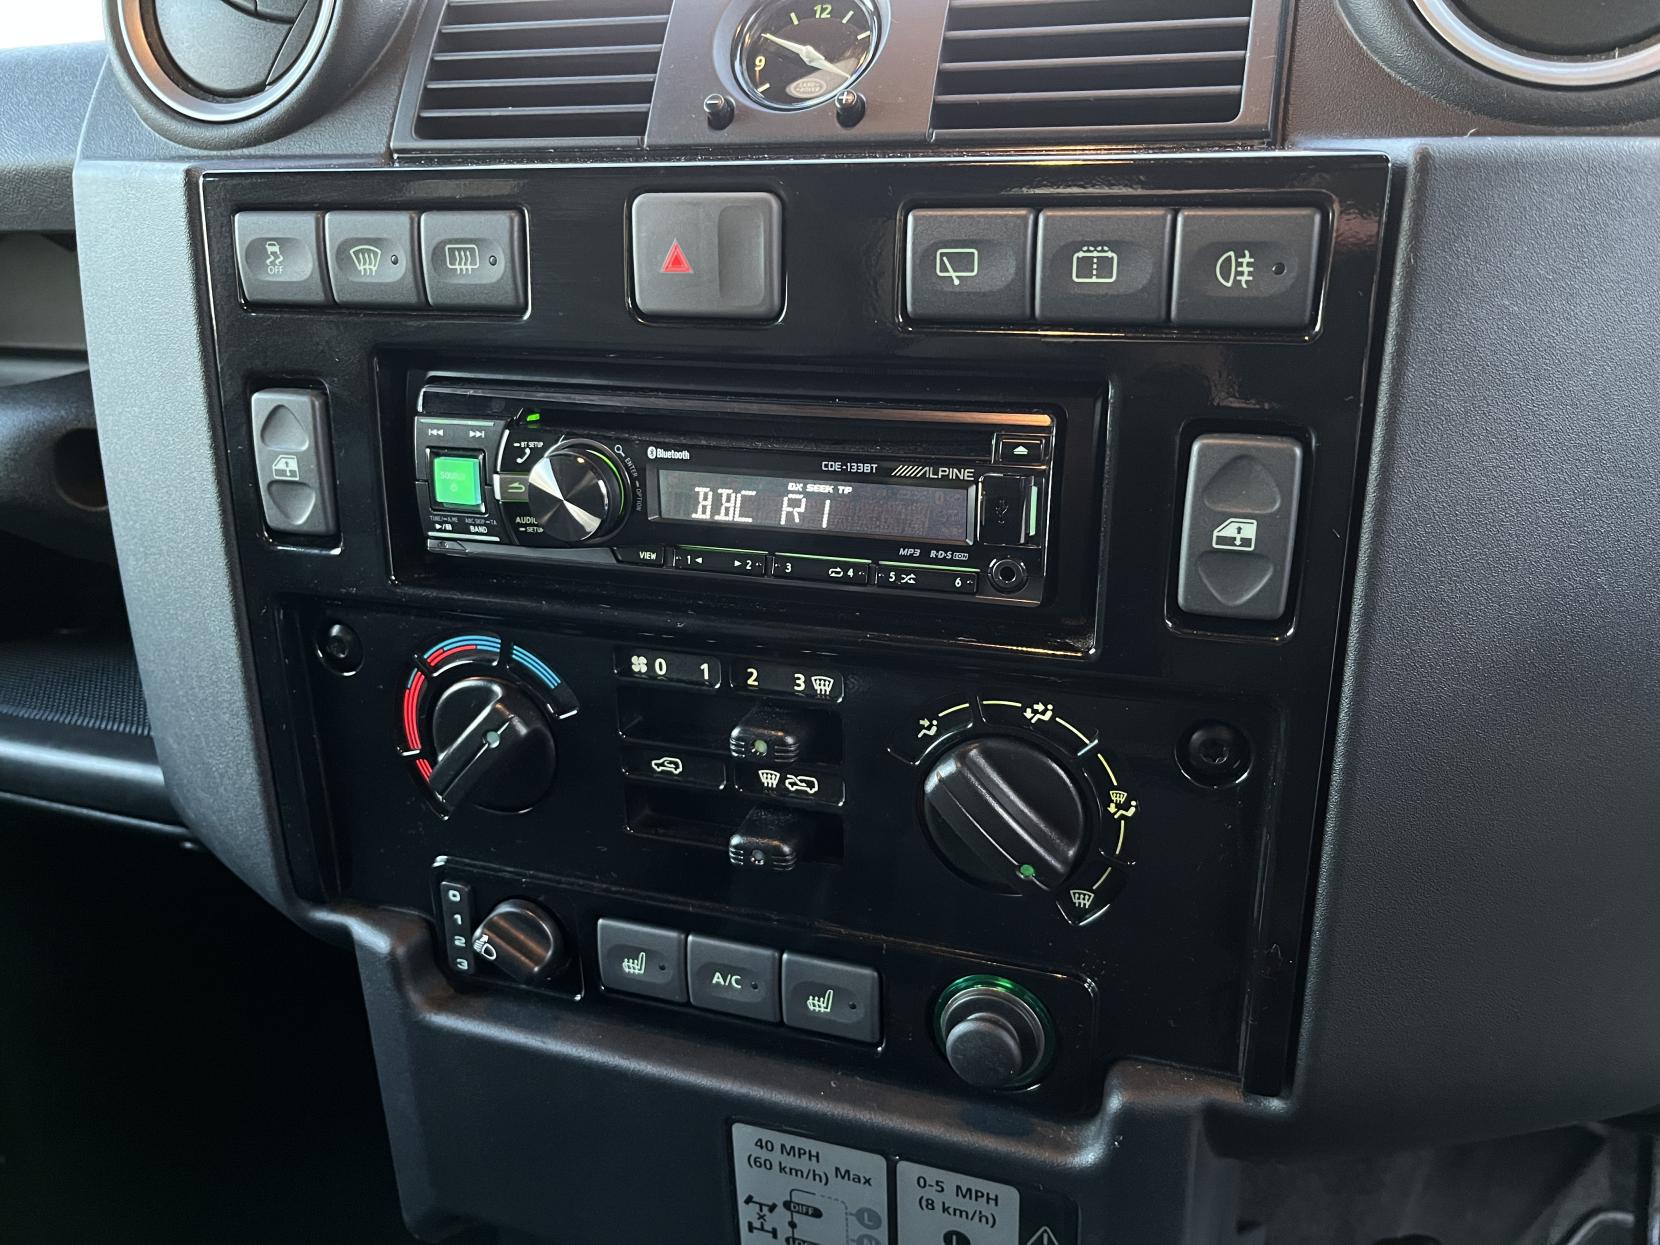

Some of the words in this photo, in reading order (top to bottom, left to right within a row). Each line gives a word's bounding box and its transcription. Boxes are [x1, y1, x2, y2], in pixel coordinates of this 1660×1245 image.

[814, 4, 832, 19] 12
[754, 55, 765, 71] 9
[267, 265, 284, 275] OFF
[656, 448, 690, 460] Bluetooth
[624, 457, 638, 478] ENTER
[821, 461, 878, 473] CDE-133BT
[916, 466, 975, 480] ALPINE
[806, 483, 835, 493] SEEK
[691, 486, 757, 523] BBC
[469, 525, 488, 534] BAND
[639, 551, 657, 561] VIEW
[899, 548, 921, 557] MP3
[686, 555, 691, 564] 1
[746, 560, 752, 570] 2
[785, 563, 792, 573] 3
[847, 568, 854, 578] 4
[889, 572, 896, 582] 5
[954, 578, 962, 588] 6
[654, 658, 667, 676] 0
[700, 663, 709, 680] 1
[746, 668, 759, 686] 2
[793, 673, 806, 691] 3
[448, 890, 461, 902] 0
[453, 914, 462, 925] 1
[454, 936, 466, 947] 2
[457, 958, 468, 970] 3
[712, 971, 742, 989] A/C
[754, 1138, 774, 1152] 40
[780, 1143, 820, 1163] MPH
[747, 1154, 773, 1171] (60
[779, 1161, 829, 1186] km/h)
[834, 1166, 872, 1187] Max
[916, 1175, 945, 1193] 0-5
[955, 1184, 999, 1207] MPH
[791, 1202, 815, 1216] DIFF
[918, 1195, 935, 1211] (8
[942, 1201, 996, 1228] km/h)
[863, 1211, 873, 1226] L
